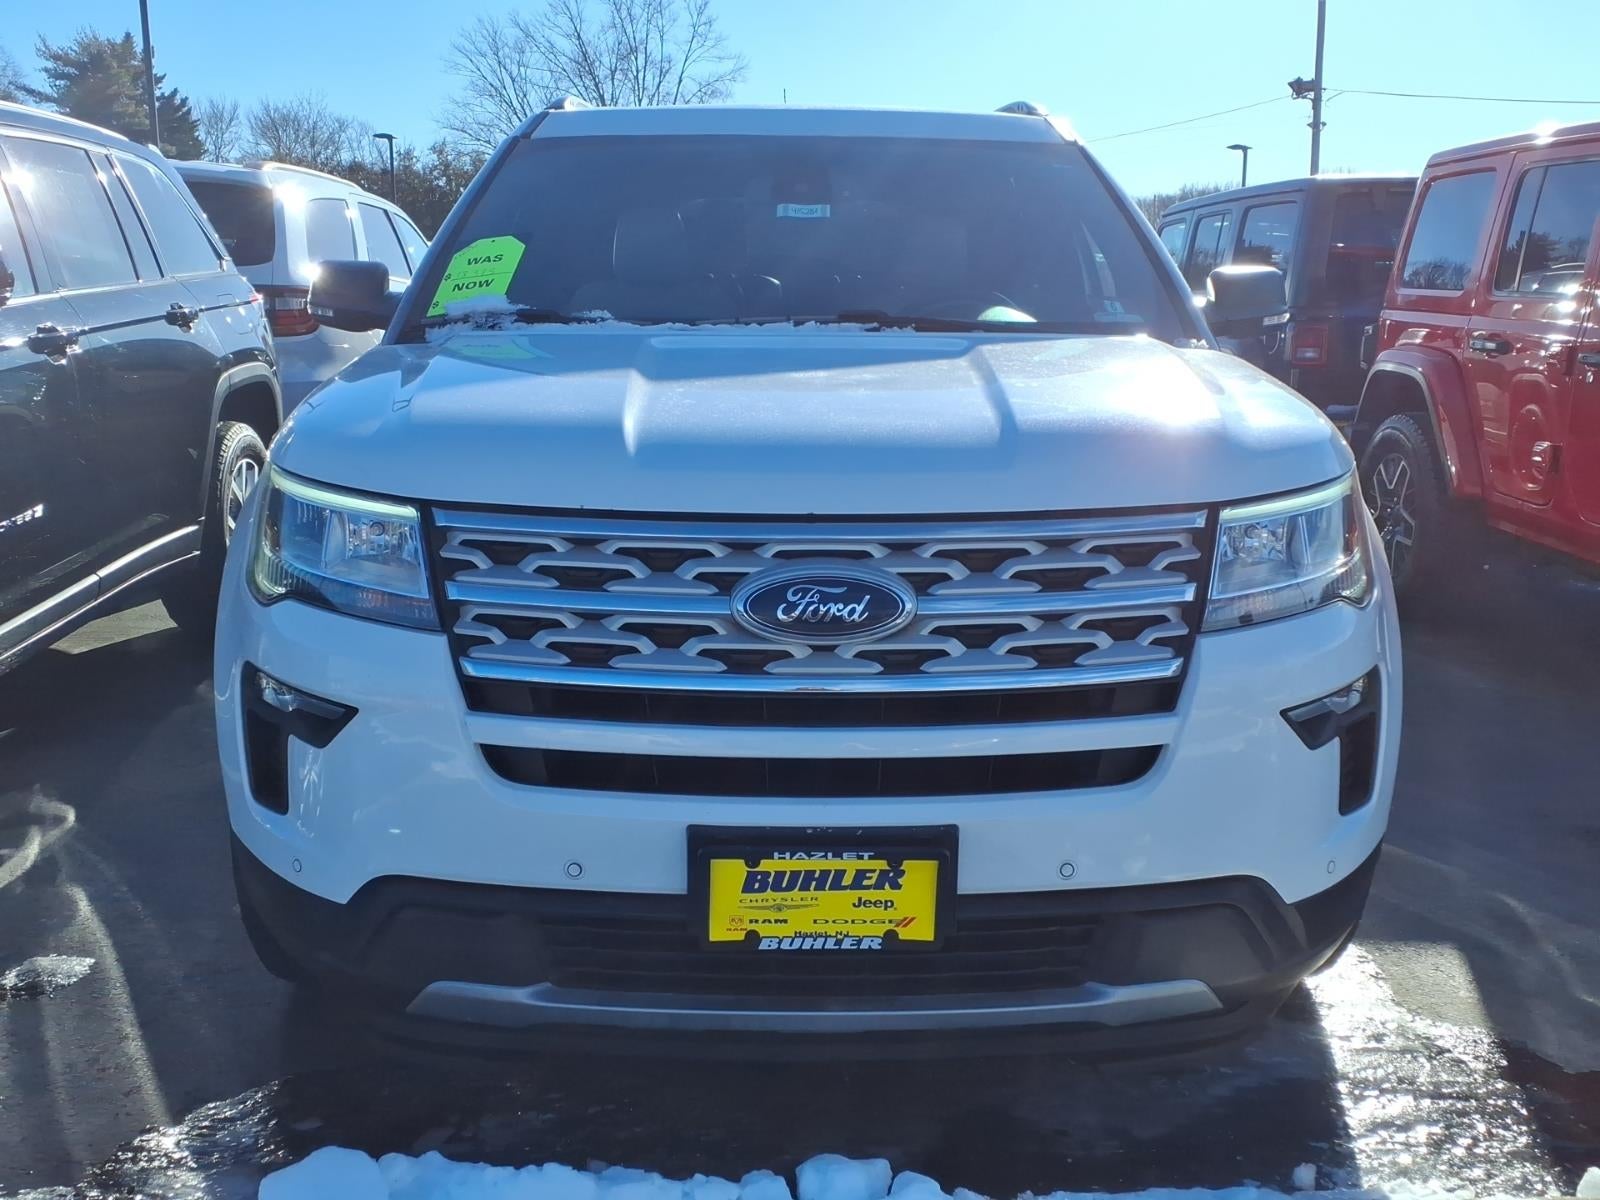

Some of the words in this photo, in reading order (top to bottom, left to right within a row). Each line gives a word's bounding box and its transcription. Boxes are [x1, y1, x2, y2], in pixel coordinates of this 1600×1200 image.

[467, 254, 503, 265] WAS
[452, 279, 494, 292] NOW
[776, 584, 871, 623] Ford
[773, 851, 875, 861] HAZLET
[741, 869, 905, 893] BUHLER
[852, 897, 894, 910] Jeep
[758, 937, 882, 950] BUHLER
